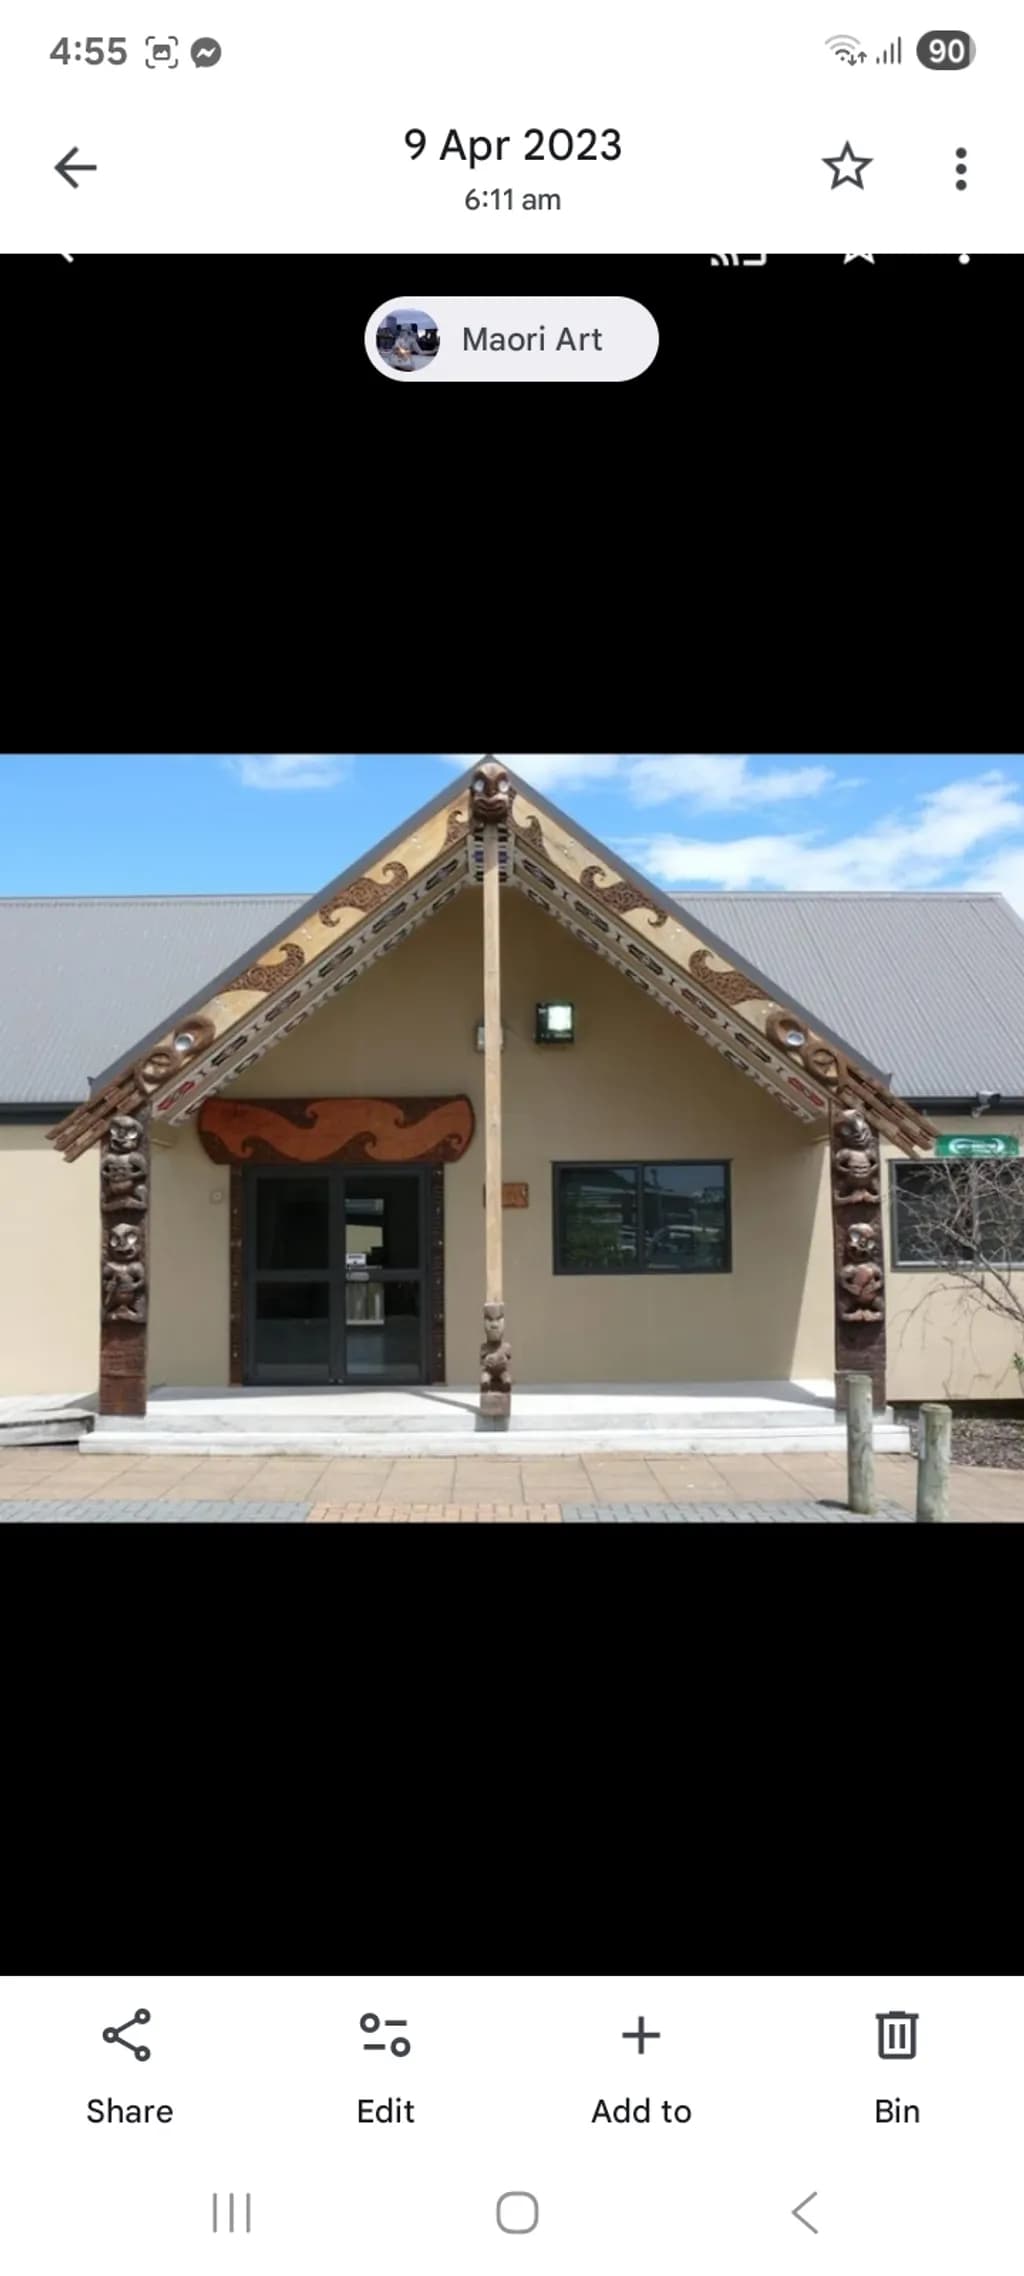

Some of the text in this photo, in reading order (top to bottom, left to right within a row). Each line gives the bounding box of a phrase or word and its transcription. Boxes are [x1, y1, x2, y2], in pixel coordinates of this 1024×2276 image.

[50, 38, 127, 65] 4:55
[929, 38, 965, 63] 90
[404, 128, 622, 170] 9 Apr 2023
[465, 188, 561, 211] 6:11 am
[463, 325, 603, 352] Maori Art
[86, 2096, 174, 2124] Share
[358, 2096, 415, 2124] Edit
[591, 2096, 692, 2124] Add to
[875, 2096, 920, 2124] Bin
